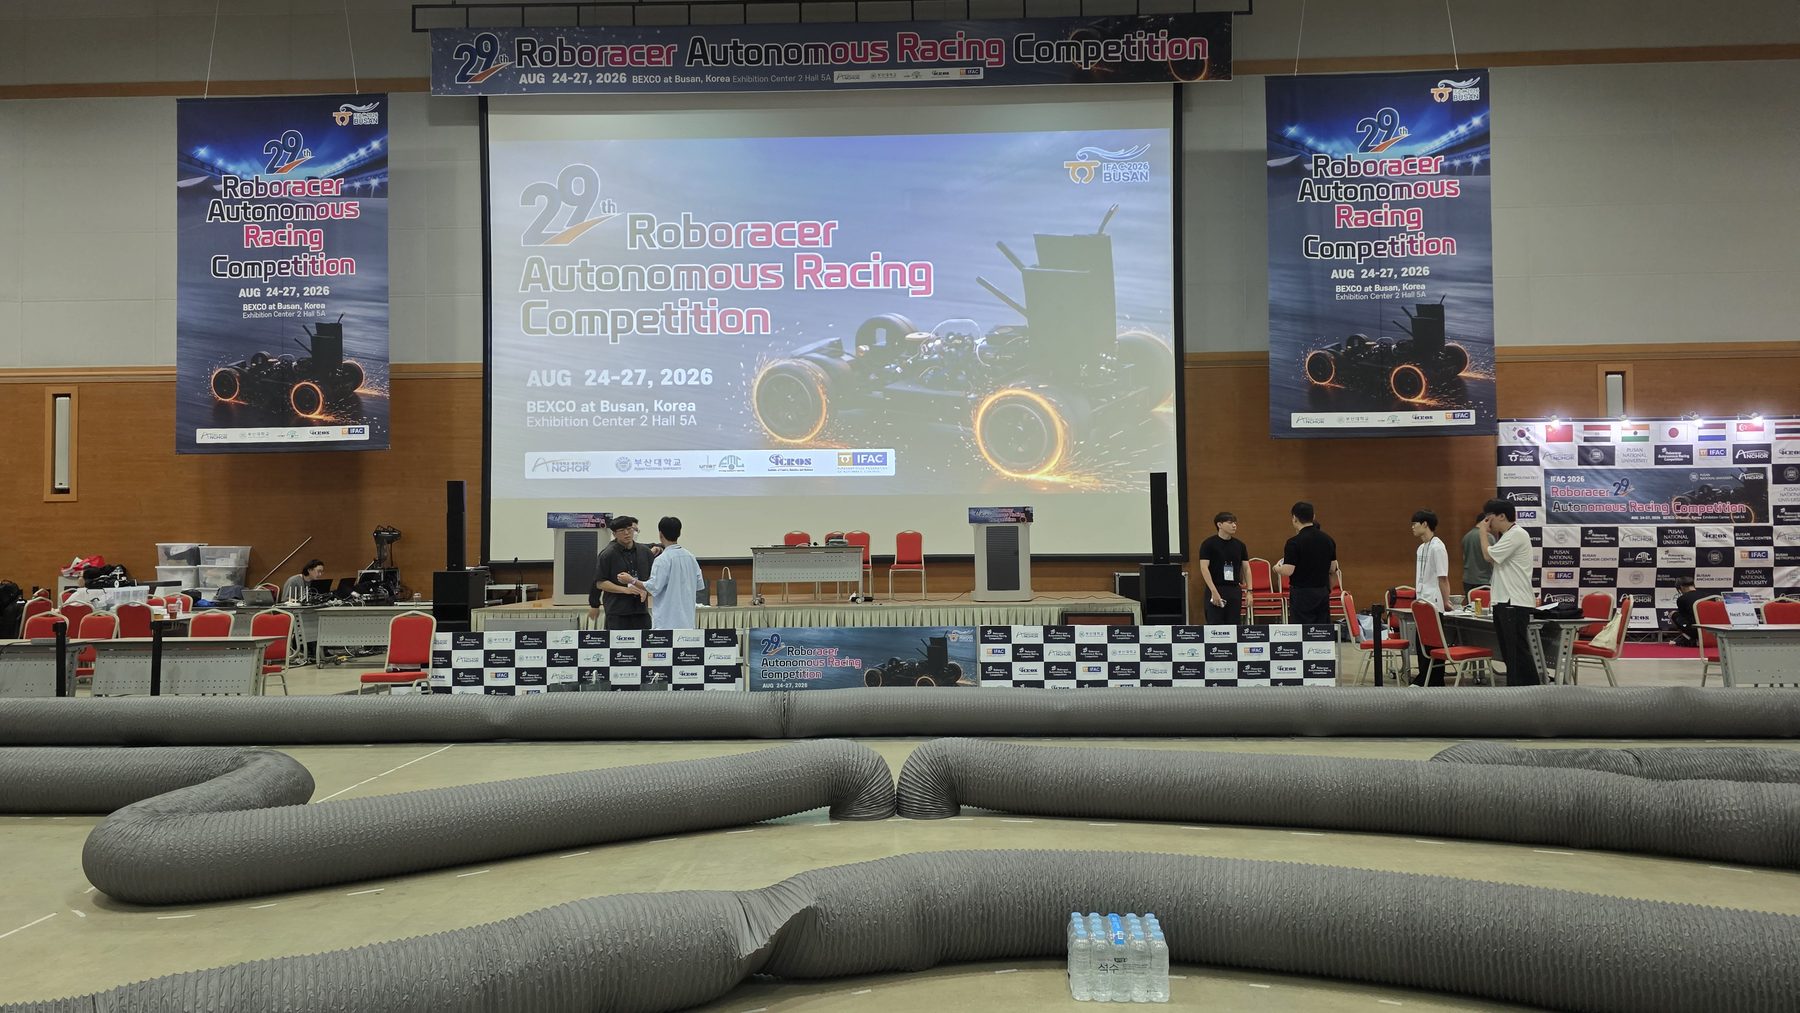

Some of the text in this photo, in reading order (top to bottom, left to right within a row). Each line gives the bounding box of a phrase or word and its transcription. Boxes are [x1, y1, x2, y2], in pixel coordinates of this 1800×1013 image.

[515, 35, 678, 68] Roboracer
[685, 35, 889, 67] Autonomous
[897, 31, 1005, 67] Racing
[1013, 30, 1209, 70] Competition
[519, 73, 545, 85] AUG
[552, 73, 592, 87] 24-27,
[596, 72, 628, 84] 2026
[632, 75, 661, 84] BEXCO
[663, 75, 673, 84] at
[675, 74, 703, 85] Busan,
[705, 73, 731, 83] Korea
[732, 74, 769, 84] Exhibition
[770, 74, 796, 83] Center
[798, 74, 803, 83] 2
[805, 74, 819, 83] Hall
[820, 74, 831, 82] 5A
[1312, 154, 1444, 179] Roboracer
[1103, 171, 1150, 183] BUSAN
[222, 175, 344, 199] Roboracer
[1297, 177, 1460, 203] Autonomous
[206, 199, 360, 222] Autonomous
[1335, 203, 1423, 231] Racing
[244, 223, 323, 252] Racing
[627, 212, 839, 249] Roboracer
[1302, 232, 1456, 264] Competition
[211, 253, 355, 283] Competition
[519, 252, 934, 298] Autonomous Racing
[1331, 266, 1430, 279] AUG 24-27, 2026
[238, 286, 330, 298] AUG 24-27, 2026
[1374, 284, 1400, 292] Busan,
[243, 303, 267, 311] BEXCO
[277, 303, 302, 311] Busan,
[304, 302, 326, 310] Korea
[242, 311, 273, 319] Exhibition
[520, 298, 771, 344] Competition
[526, 368, 713, 389] AUG 24-27, 2026
[526, 400, 696, 414] BEXCO at Busan, Korea
[526, 414, 697, 428] Exhibition Center 2 Hall 5A
[634, 458, 682, 468] 부산대학교
[857, 454, 883, 463] IFAC
[1551, 486, 1610, 498] Roboracer
[1552, 500, 1746, 516] Autonomous Racing Competition
[787, 646, 839, 656] Roboracer
[761, 656, 862, 669] Autonomous Racing
[761, 669, 822, 681] Competition
[1098, 963, 1119, 974] 석수
